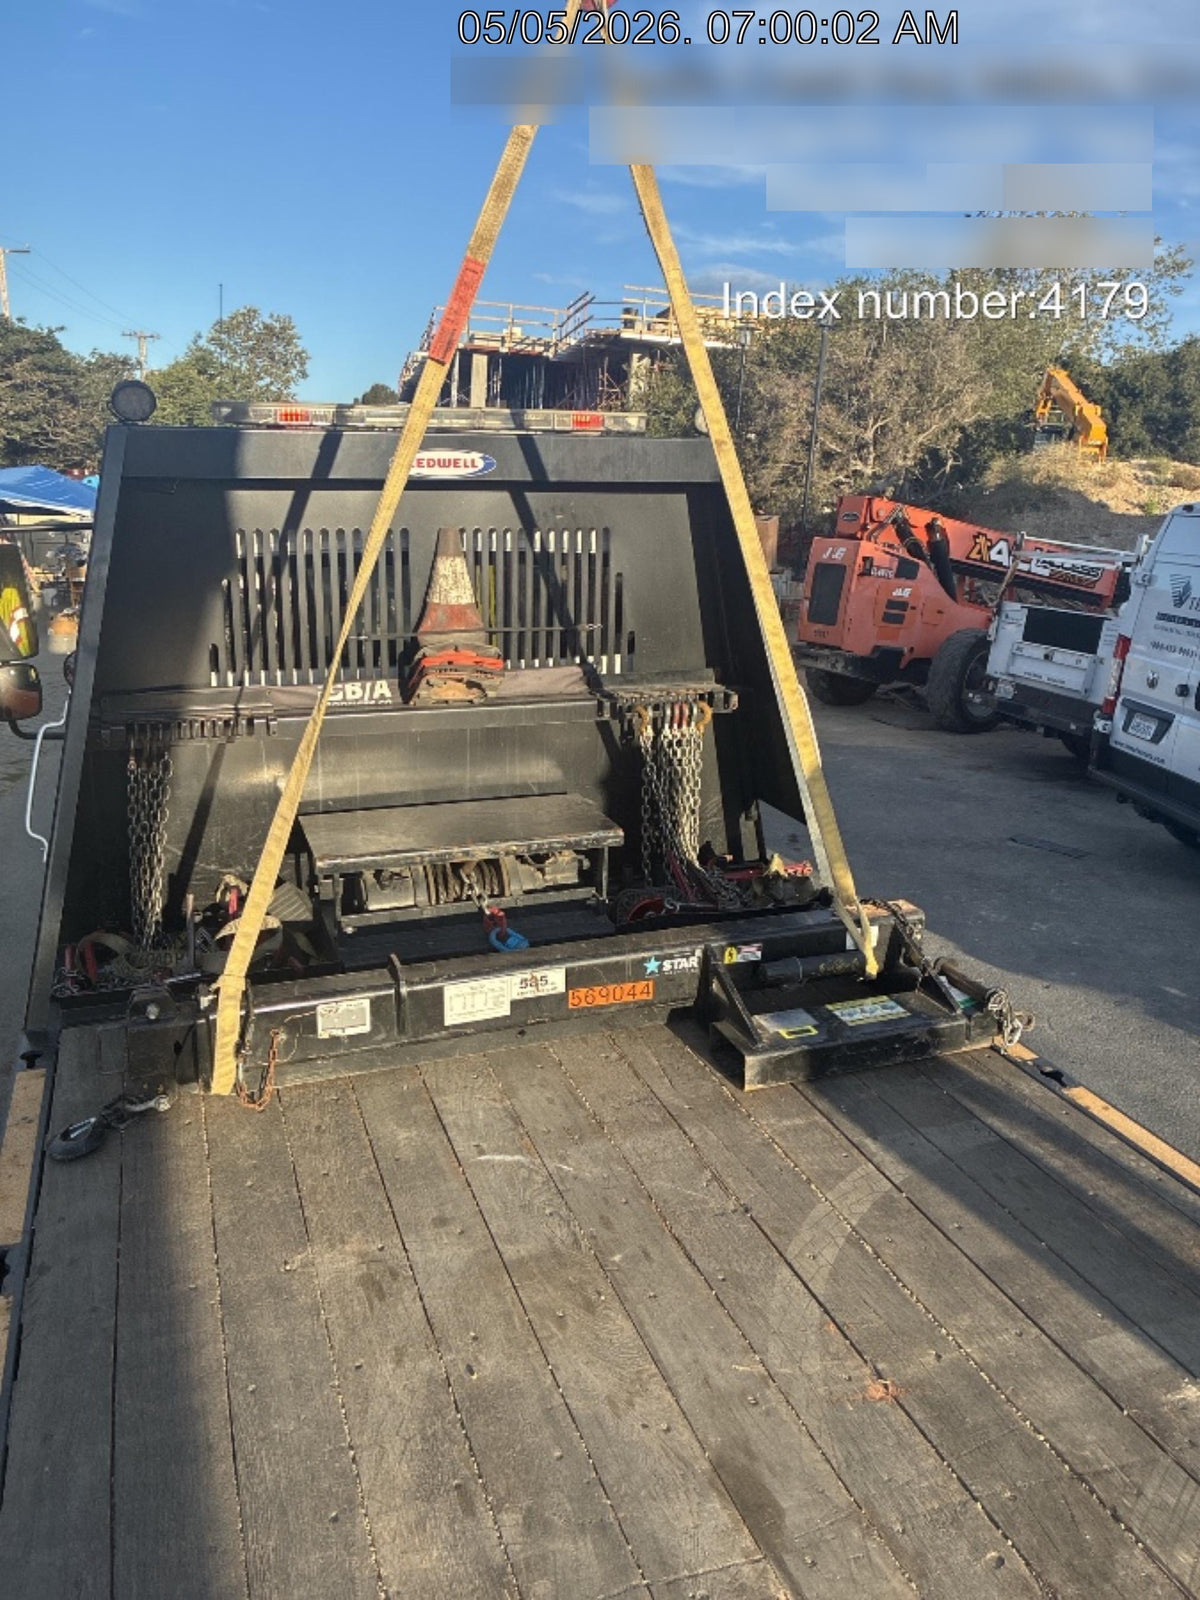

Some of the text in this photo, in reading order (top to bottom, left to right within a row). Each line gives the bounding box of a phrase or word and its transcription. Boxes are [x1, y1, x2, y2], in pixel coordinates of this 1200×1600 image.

[411, 457, 479, 469] EDWELL
[662, 956, 700, 971] STAR
[569, 982, 652, 1007] 569044
